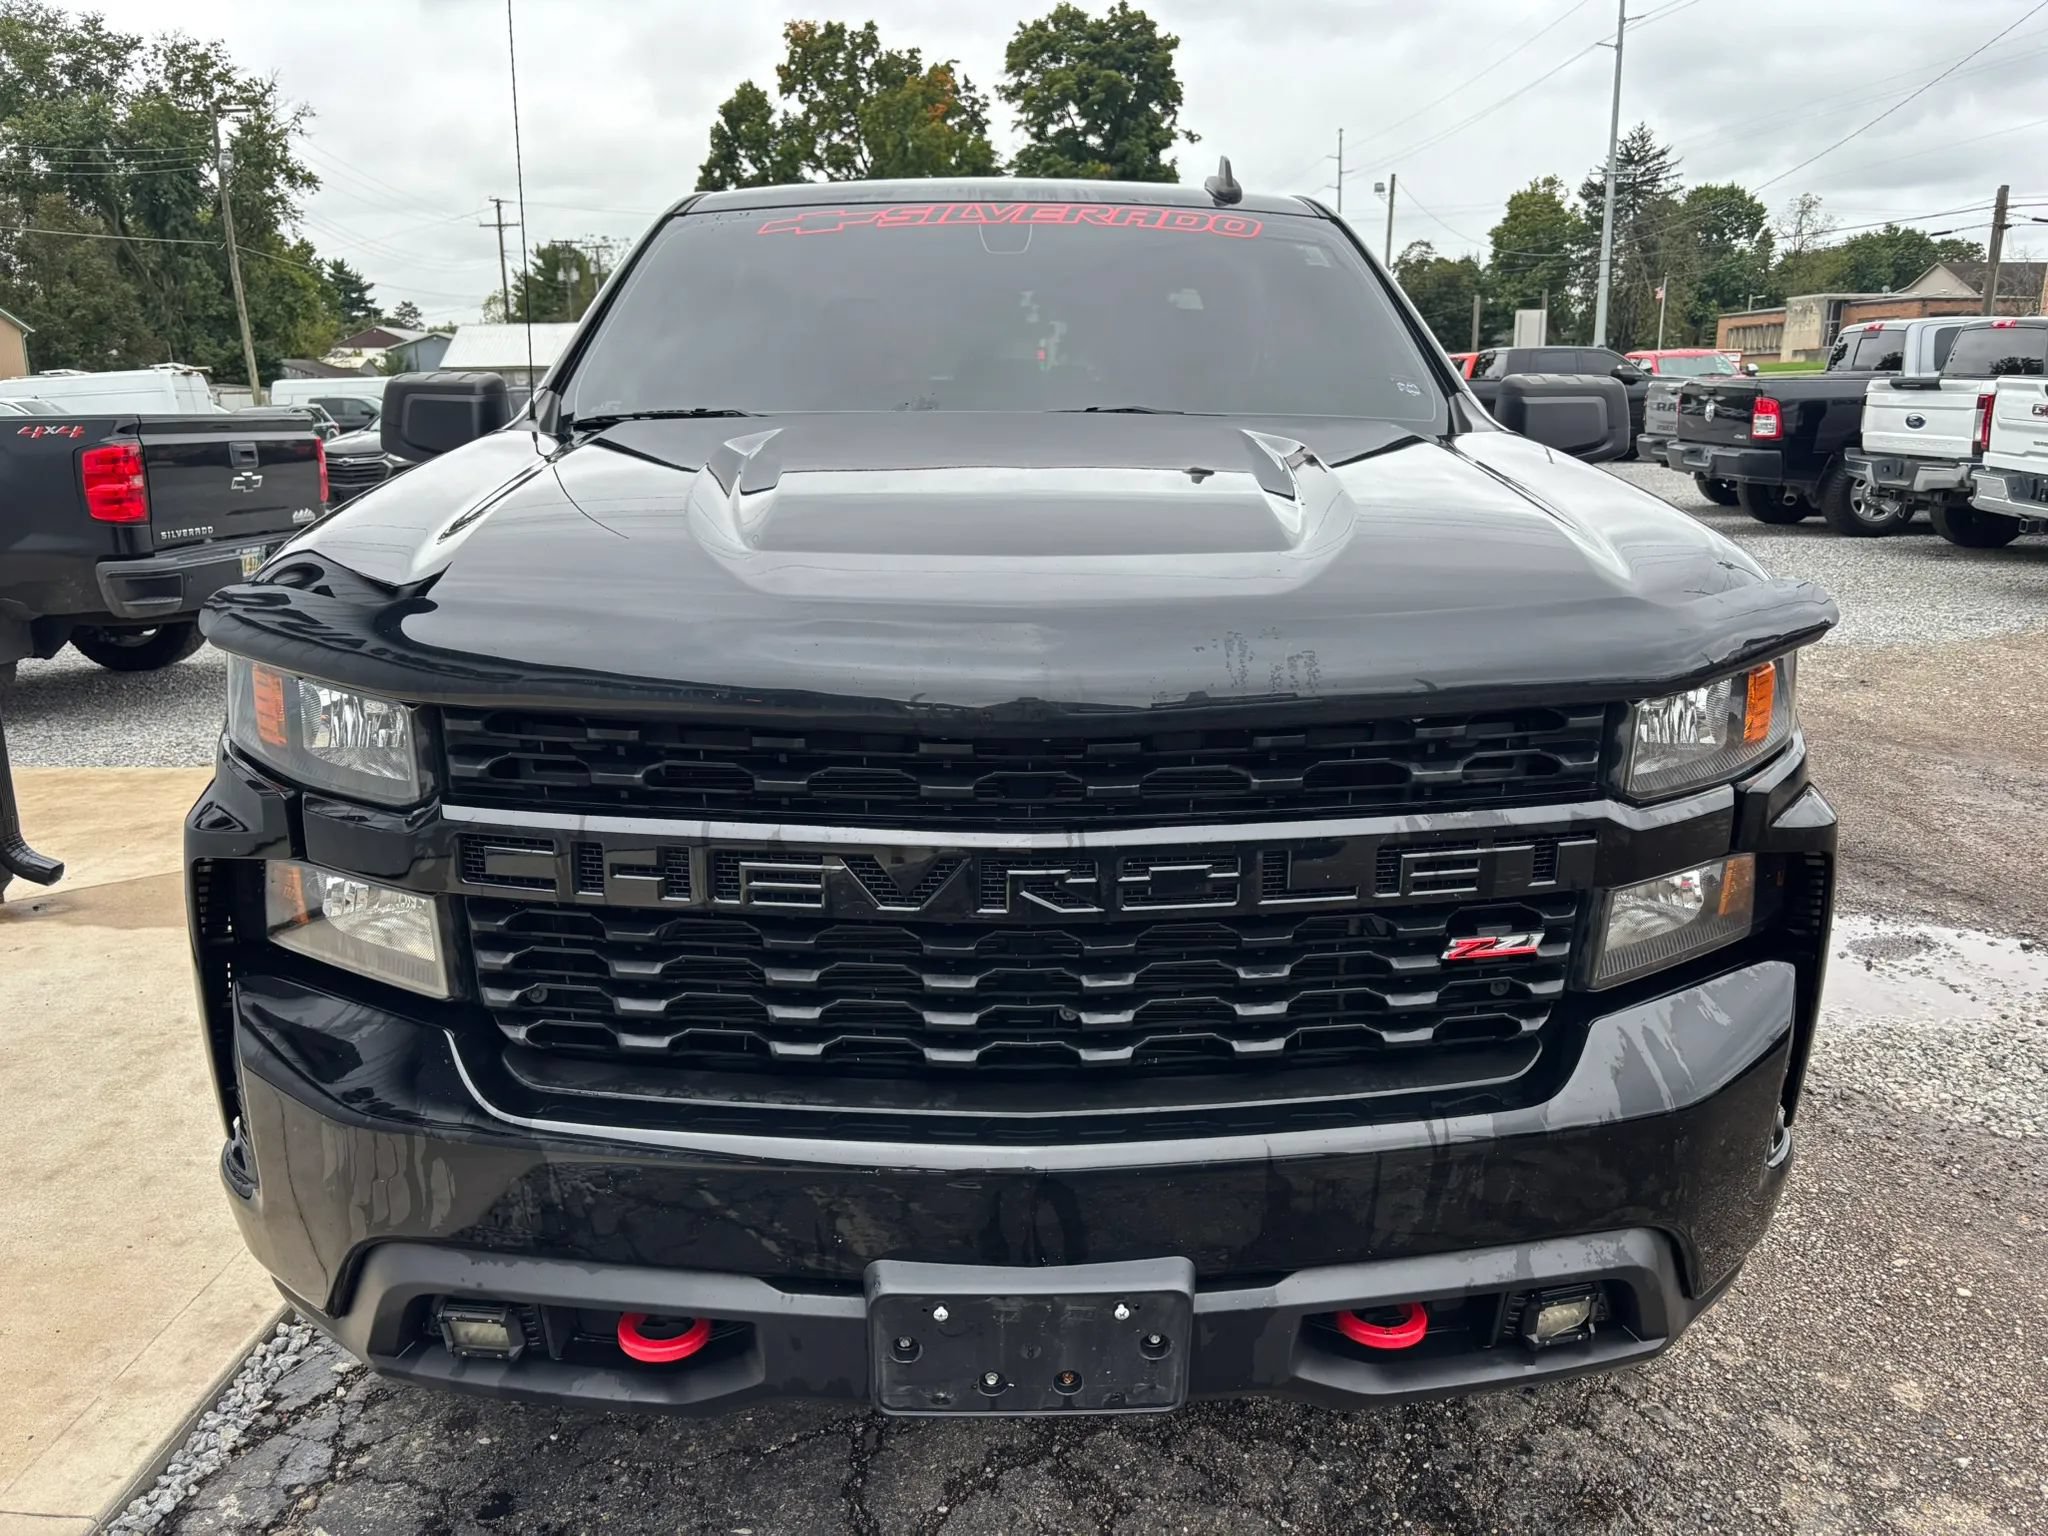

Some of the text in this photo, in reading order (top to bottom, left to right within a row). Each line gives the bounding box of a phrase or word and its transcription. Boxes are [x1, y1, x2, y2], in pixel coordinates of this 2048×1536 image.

[876, 204, 1263, 238] SILVERADO
[1656, 402, 1677, 412] RA
[160, 526, 214, 540] SILVERADO
[461, 829, 1598, 915] CHEVROLET
[1441, 932, 1545, 960] Z71
